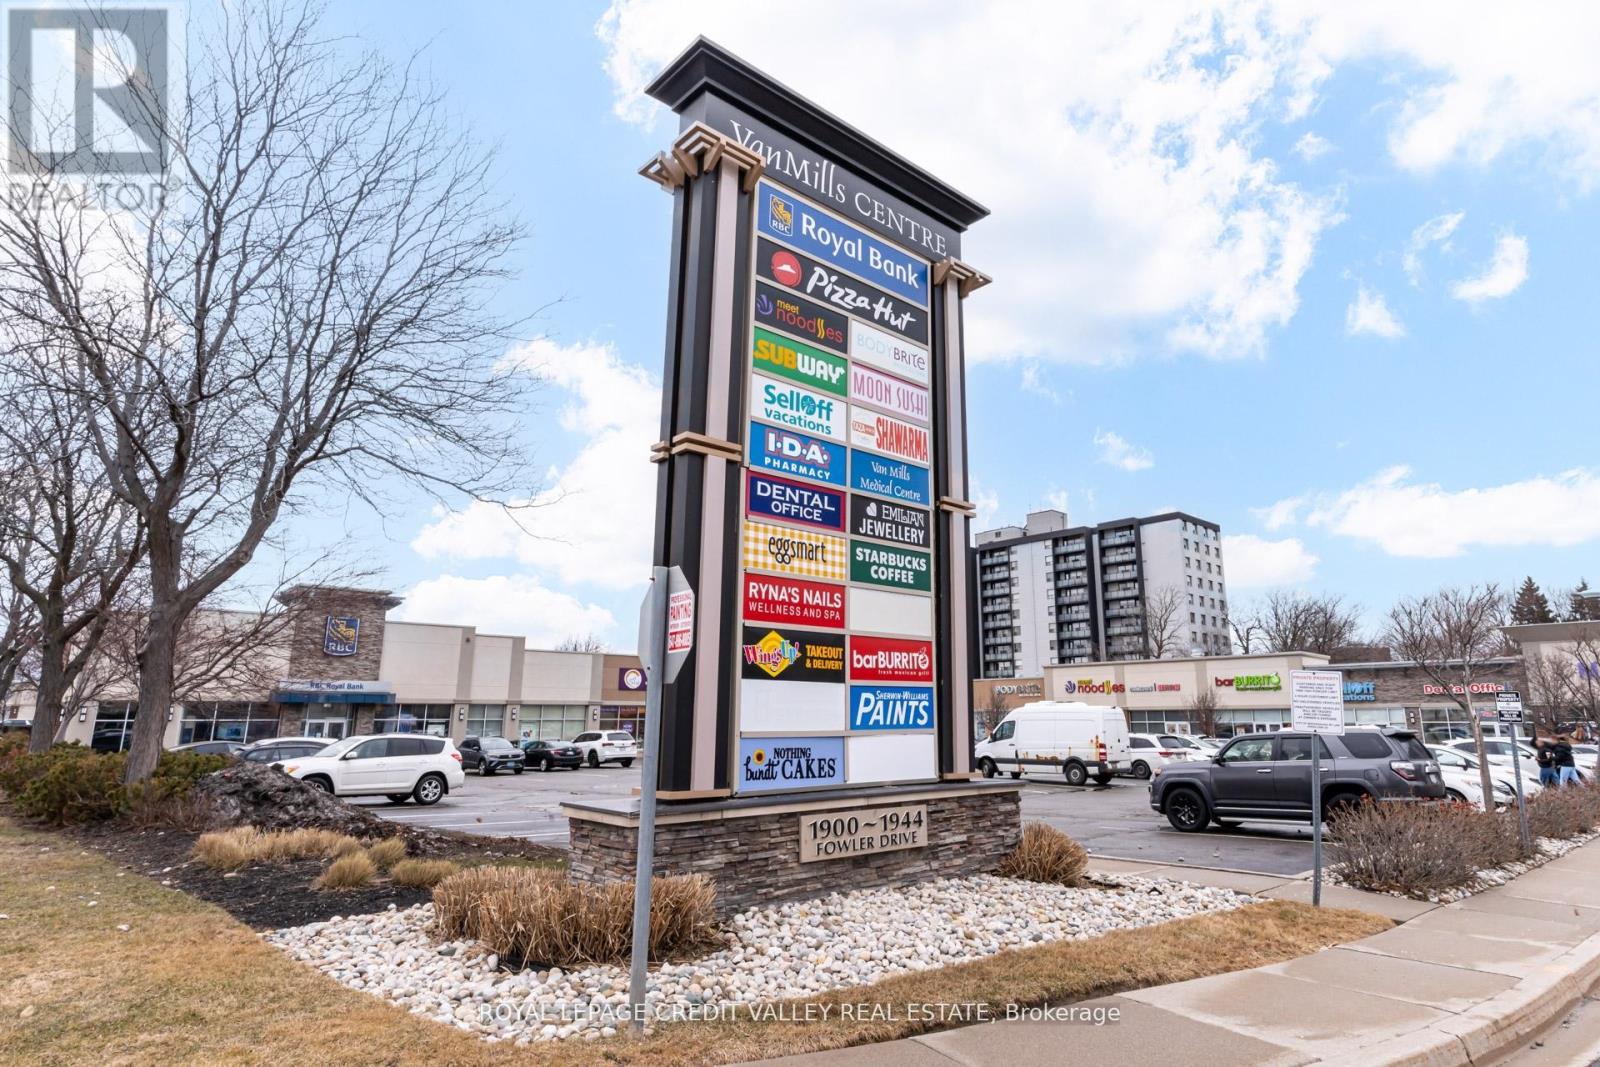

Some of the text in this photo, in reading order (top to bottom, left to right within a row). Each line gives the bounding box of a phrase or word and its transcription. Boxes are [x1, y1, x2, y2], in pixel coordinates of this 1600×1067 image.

[772, 220, 790, 233] RBC
[855, 192, 947, 257] CENTRE
[801, 212, 919, 289] Royal Bank
[776, 299, 800, 314] meet
[806, 266, 916, 331] Pizza Hut
[753, 338, 845, 385] SUBWAY
[853, 371, 928, 417] MOON SUSHI
[764, 407, 832, 435] vacations
[876, 416, 929, 462] SHAWARMA
[764, 457, 831, 480] PHARMACY
[871, 461, 910, 481] Van Mills
[756, 481, 835, 511] DENTAL
[860, 477, 921, 502] Medical Centre
[771, 501, 822, 521] OFFICE
[859, 518, 925, 544] JEWELLERY
[768, 536, 826, 565] eggsmart
[856, 547, 927, 572] STARBUCKS
[870, 565, 914, 584] COFFEE
[749, 582, 842, 608] RYNA'S NAILS
[749, 601, 841, 620] WELLNESS AND SPA
[805, 645, 843, 659] TAKEOUT
[805, 658, 844, 670] & DELIVERY
[853, 649, 929, 669] barBURRITO
[876, 690, 929, 700] SHERWIN-WILLIAMS
[1469, 683, 1504, 693] Offic
[855, 692, 929, 725] PAINTS
[773, 747, 811, 760] NOTHING
[744, 755, 836, 781] bundt CAKES
[816, 831, 918, 856] FOWLER DRIVE
